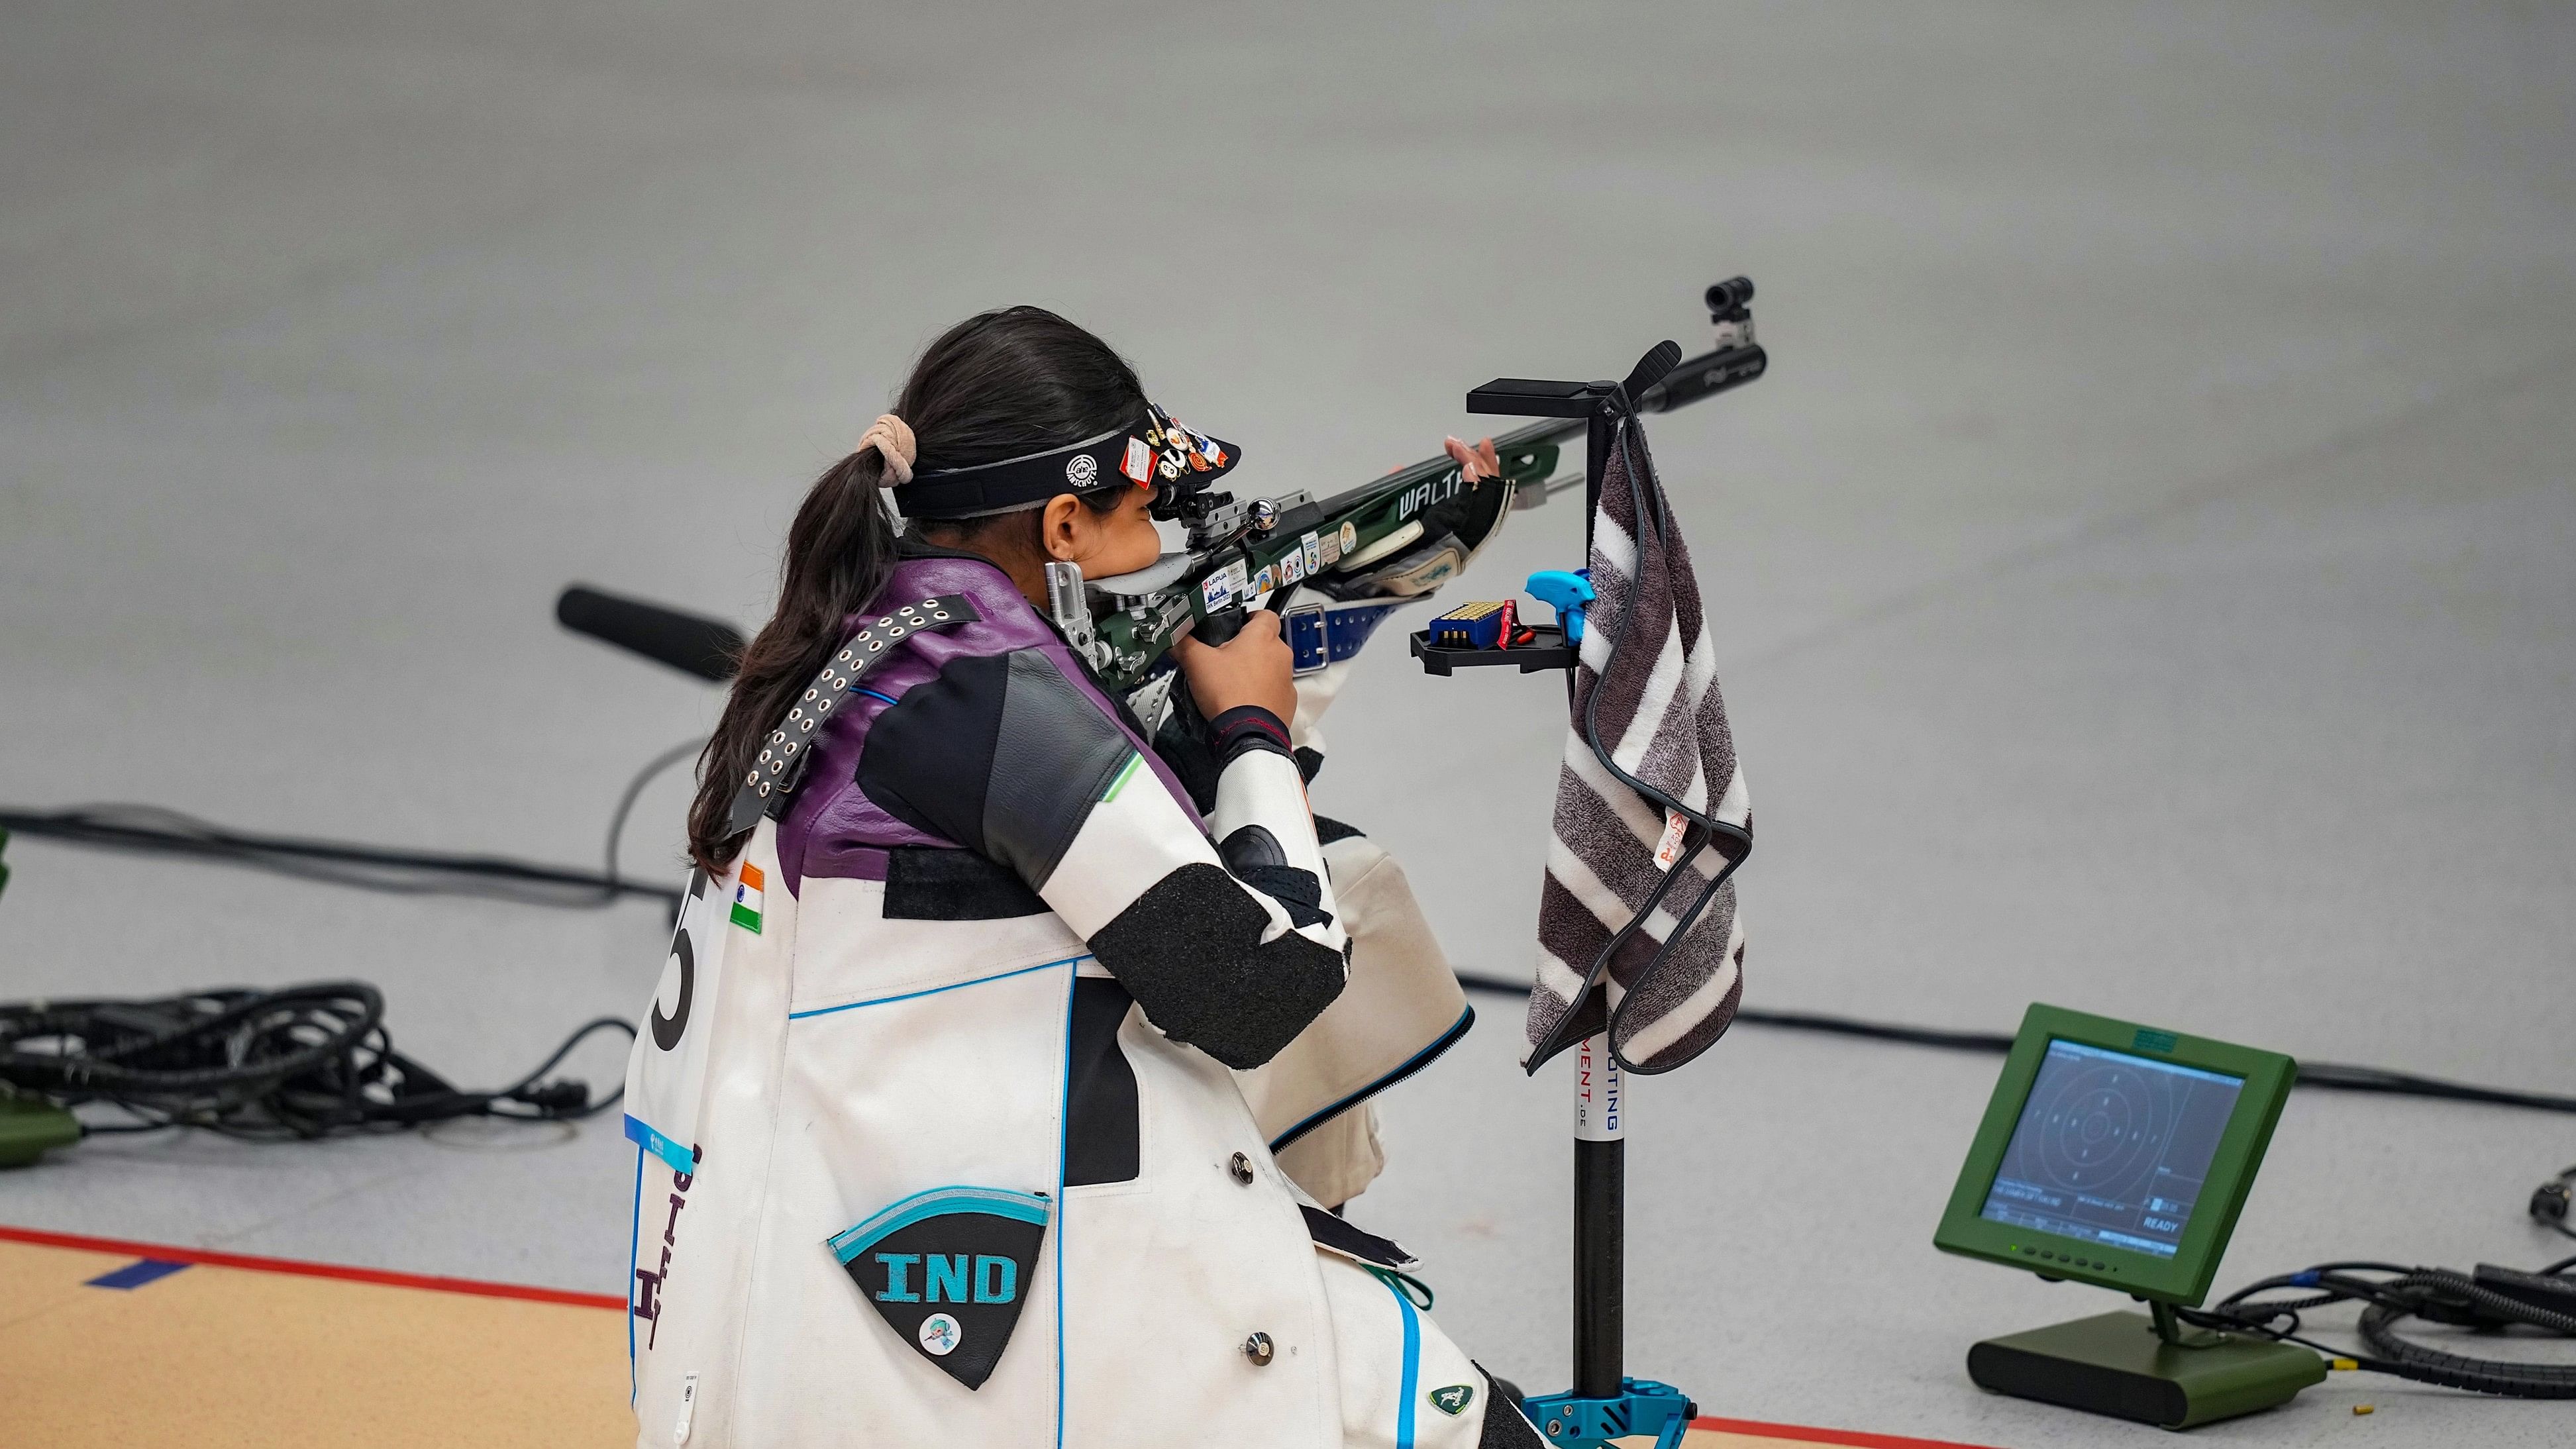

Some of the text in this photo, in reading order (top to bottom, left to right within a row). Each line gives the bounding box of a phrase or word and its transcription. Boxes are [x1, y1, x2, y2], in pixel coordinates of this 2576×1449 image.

[1209, 573, 1227, 585] LAPUA
[2143, 1216, 2179, 1233] READY
[875, 1252, 1018, 1305] IND
